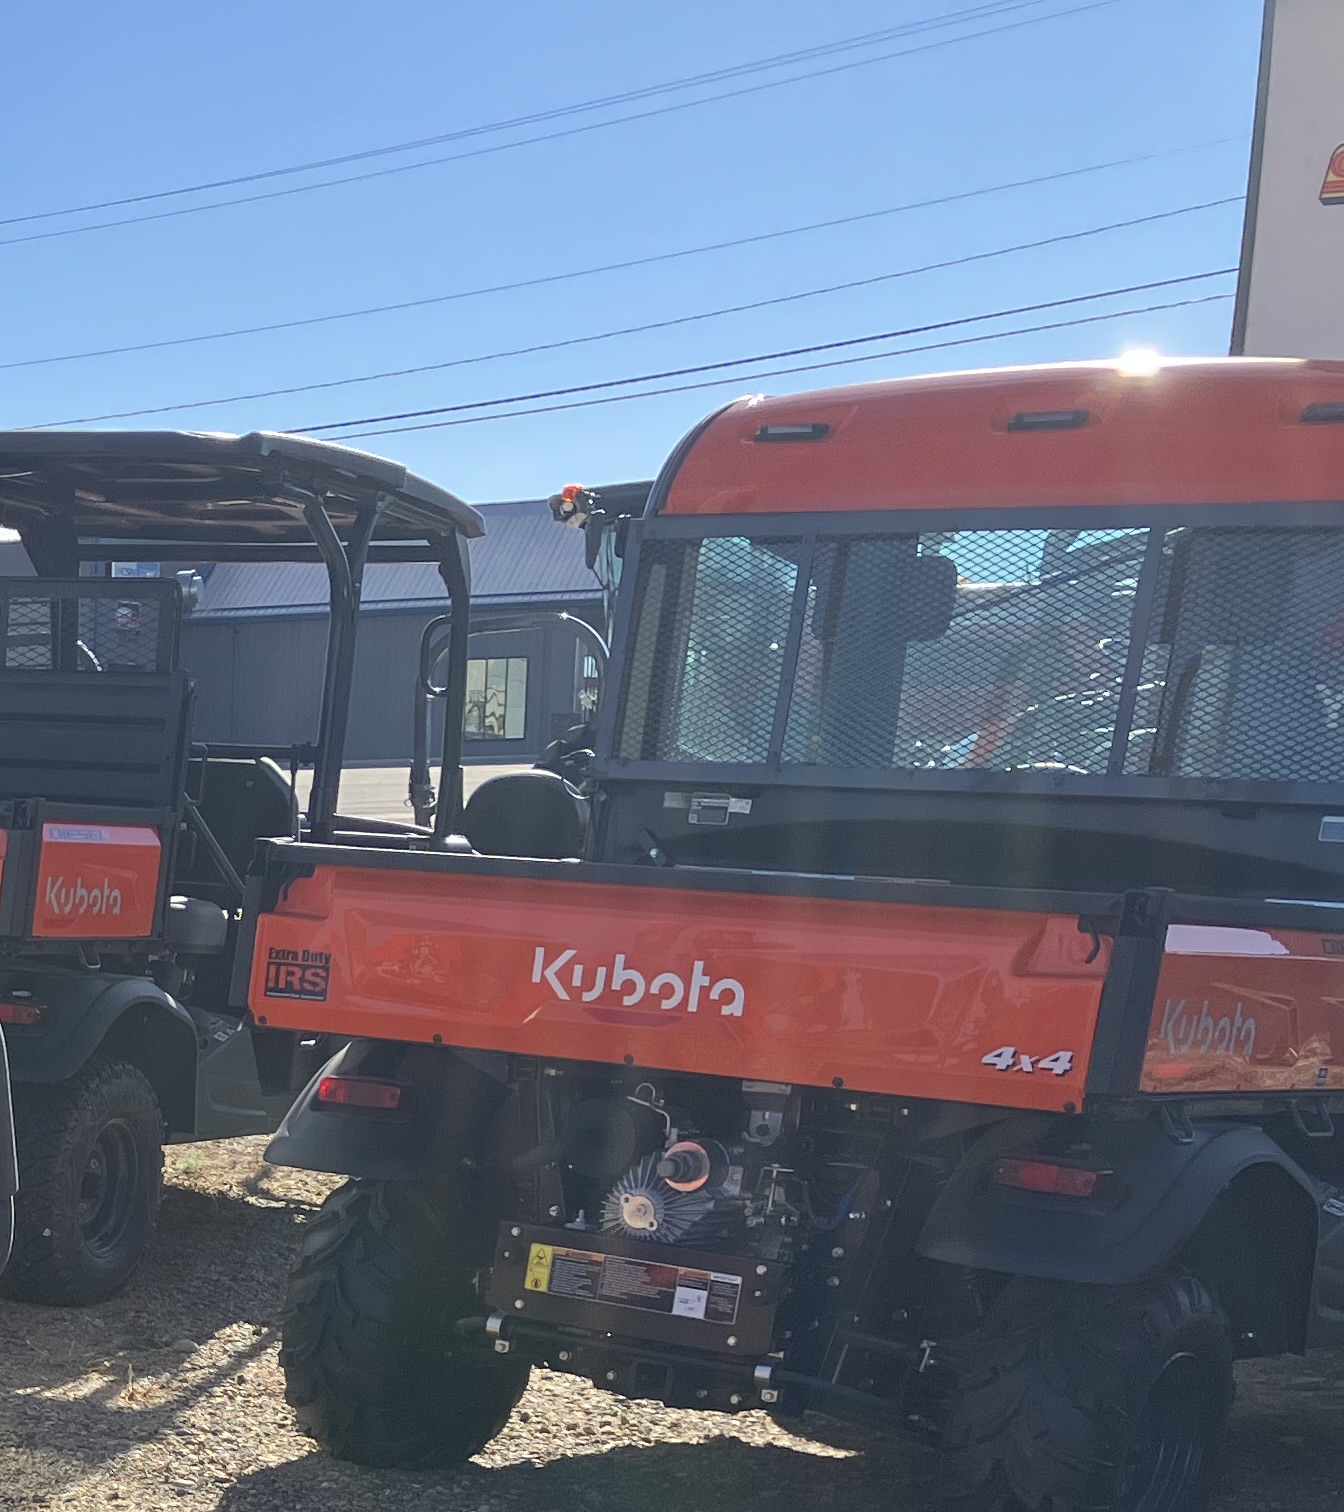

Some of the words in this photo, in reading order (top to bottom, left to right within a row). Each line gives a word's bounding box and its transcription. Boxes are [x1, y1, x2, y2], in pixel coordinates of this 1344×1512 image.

[45, 877, 121, 916] Kubota
[269, 947, 299, 961] Extra
[302, 949, 331, 965] Duty
[267, 964, 327, 992] IRS
[532, 946, 745, 1017] Kubota
[1162, 999, 1256, 1056] Kubota
[981, 1046, 1073, 1076] 4x4
